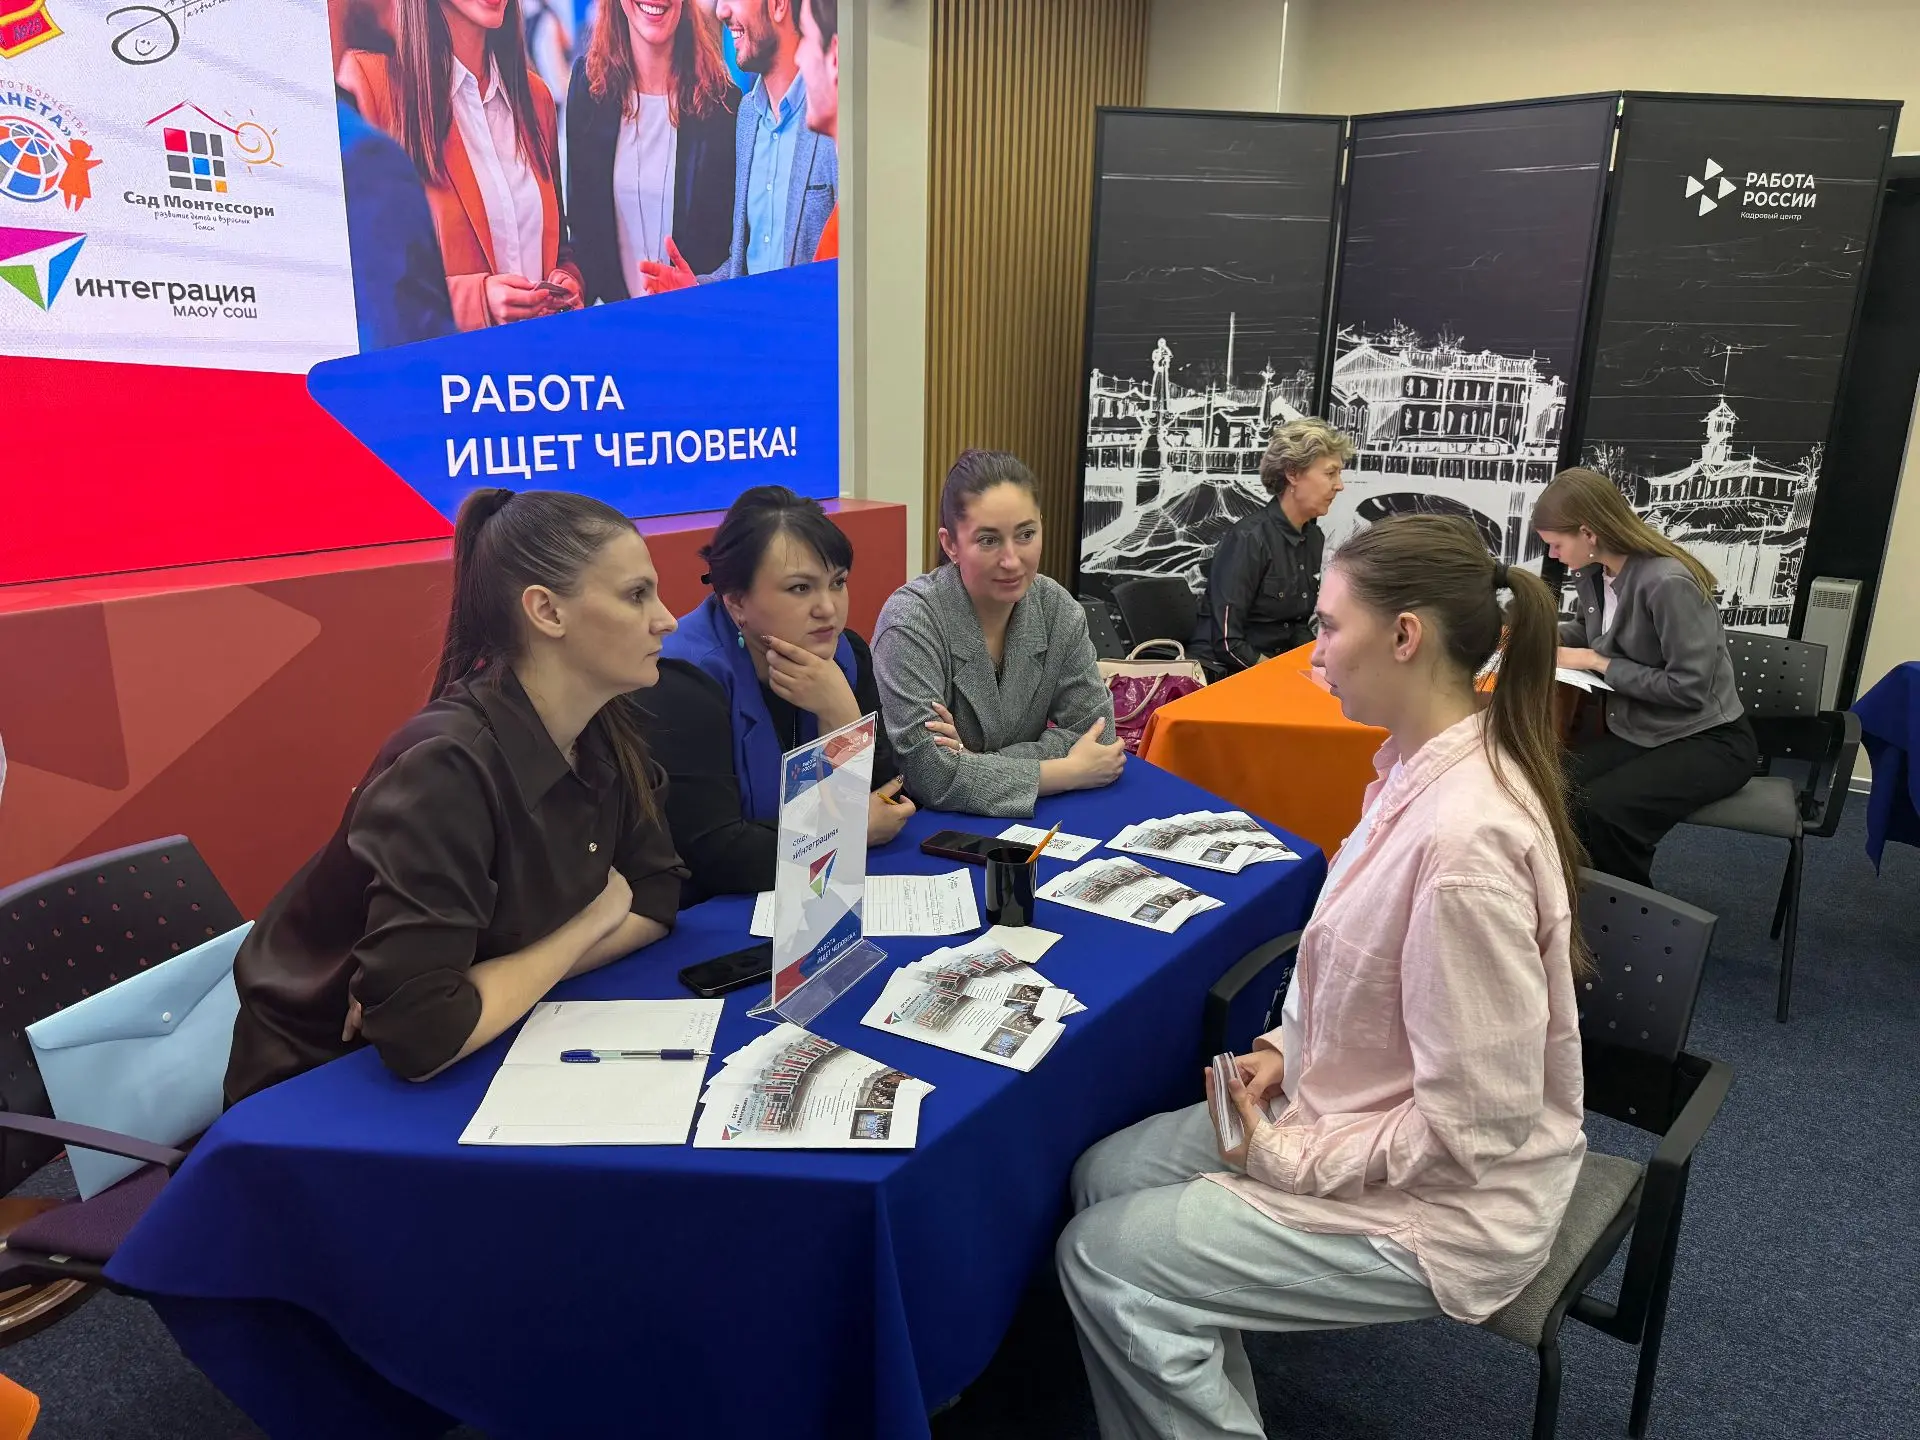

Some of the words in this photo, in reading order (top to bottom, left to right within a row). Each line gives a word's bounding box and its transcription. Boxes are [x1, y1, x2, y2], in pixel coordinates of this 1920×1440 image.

[1745, 171, 1816, 190] РАБОТА
[123, 190, 160, 209] Сад
[164, 194, 275, 218] Монтессори
[1742, 190, 1817, 208] РОССИИ
[154, 210, 189, 220] развитие
[190, 212, 211, 221] детей
[1740, 211, 1779, 220] Кадровый
[1779, 212, 1802, 221] центр
[193, 221, 216, 231] Томск
[173, 305, 218, 318] МАОУ
[222, 306, 258, 319] СОШ
[440, 374, 625, 414] РАБОТА
[445, 434, 583, 480] ИЩЕТ
[594, 426, 798, 468] ЧЕЛОВЕКА!
